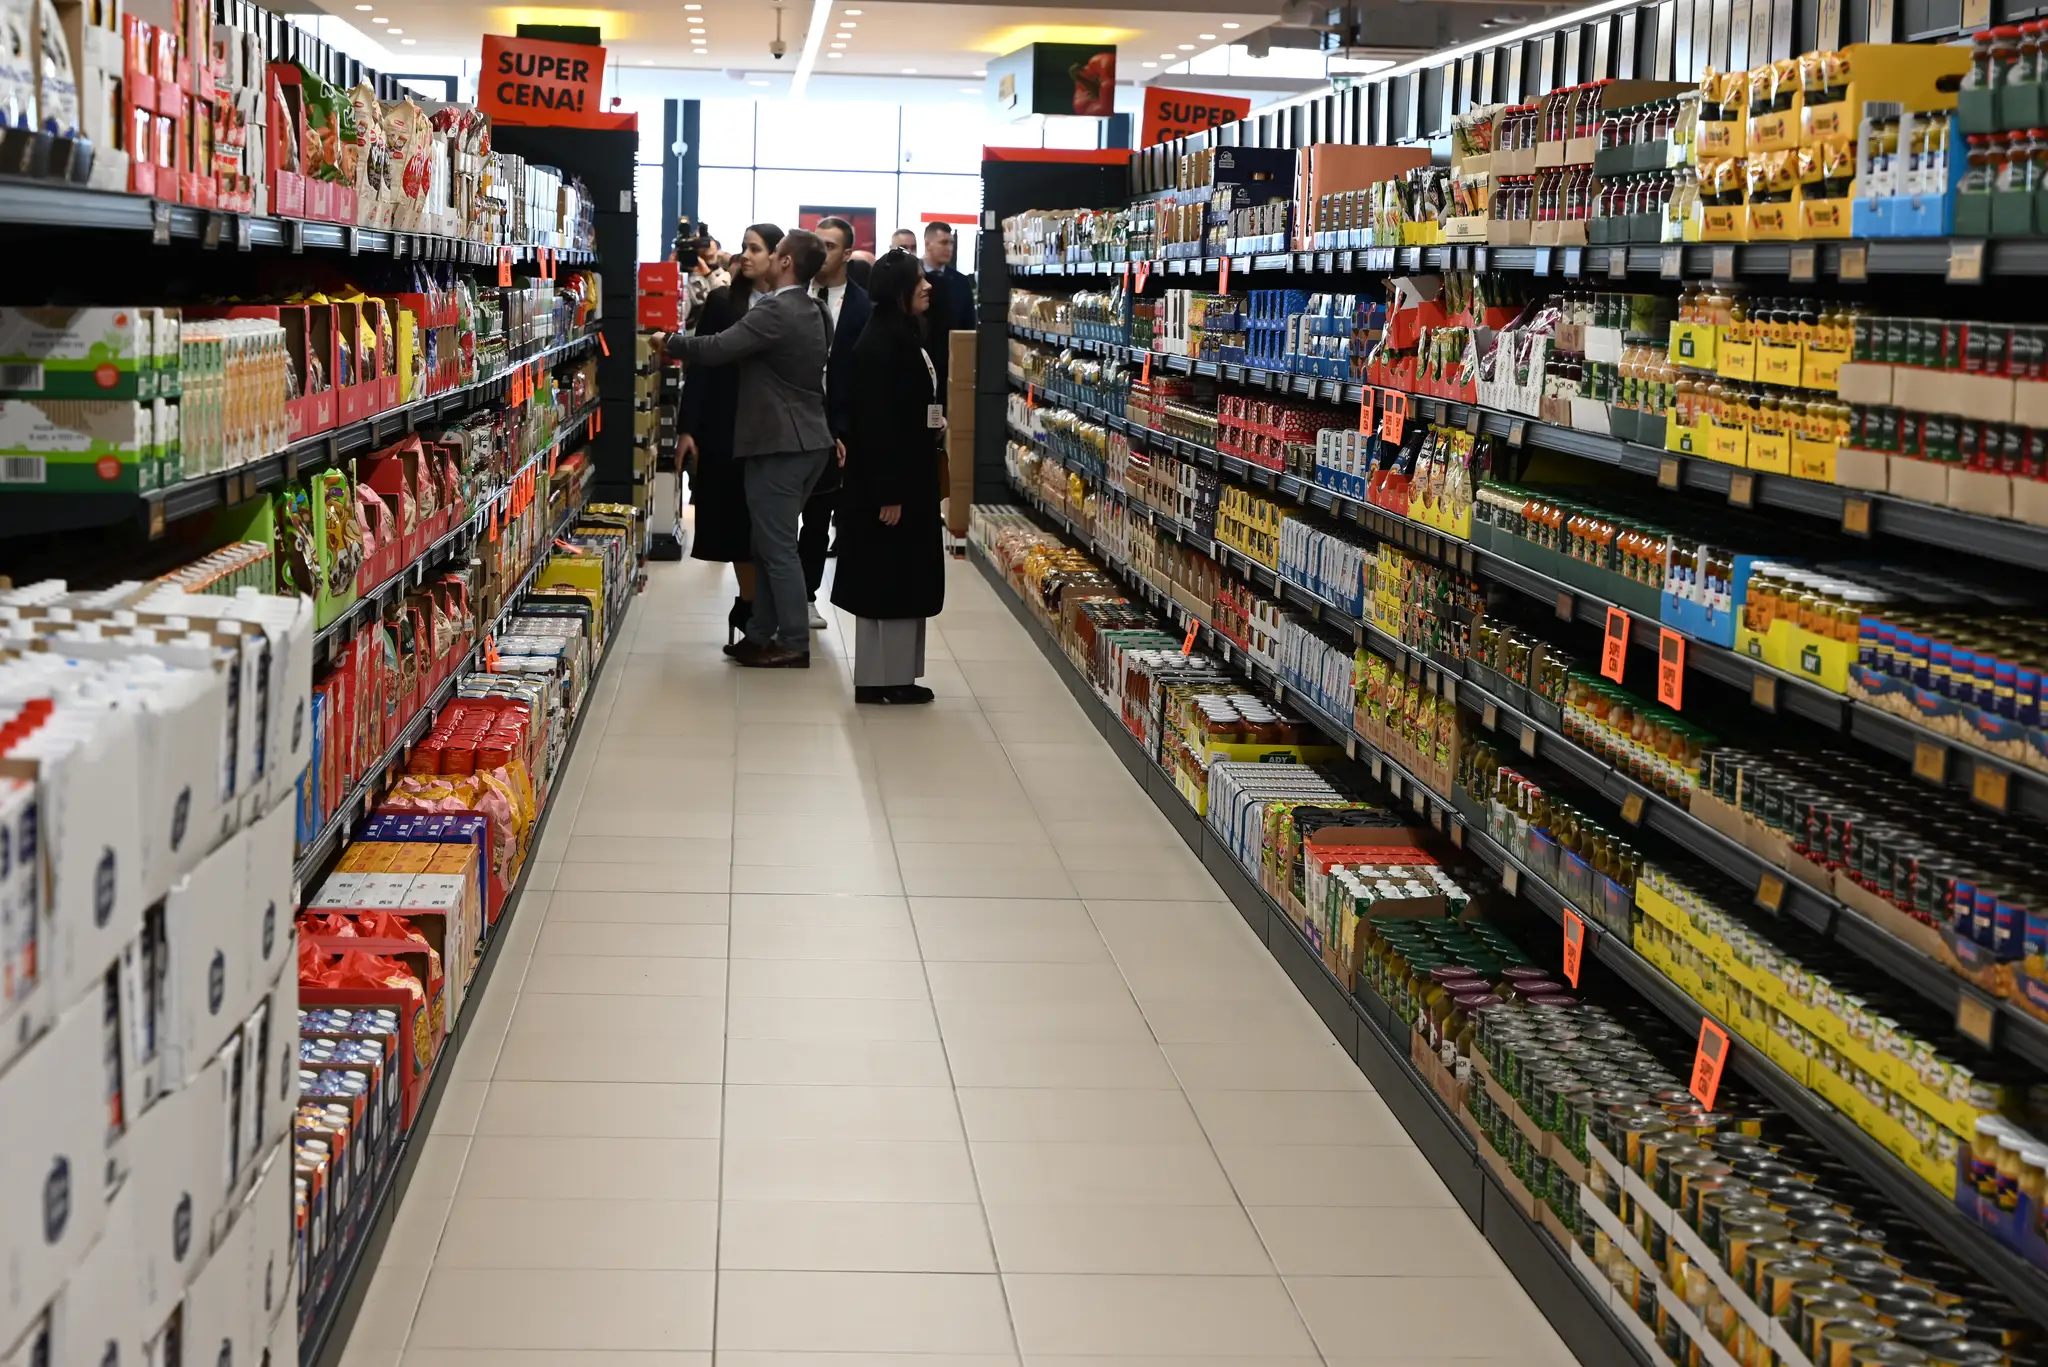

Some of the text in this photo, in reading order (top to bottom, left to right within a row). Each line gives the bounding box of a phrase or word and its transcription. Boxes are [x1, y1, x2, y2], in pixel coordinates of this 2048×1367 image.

[498, 51, 589, 83] SUPER
[497, 81, 585, 112] CENA!
[1158, 102, 1237, 126] SUPER
